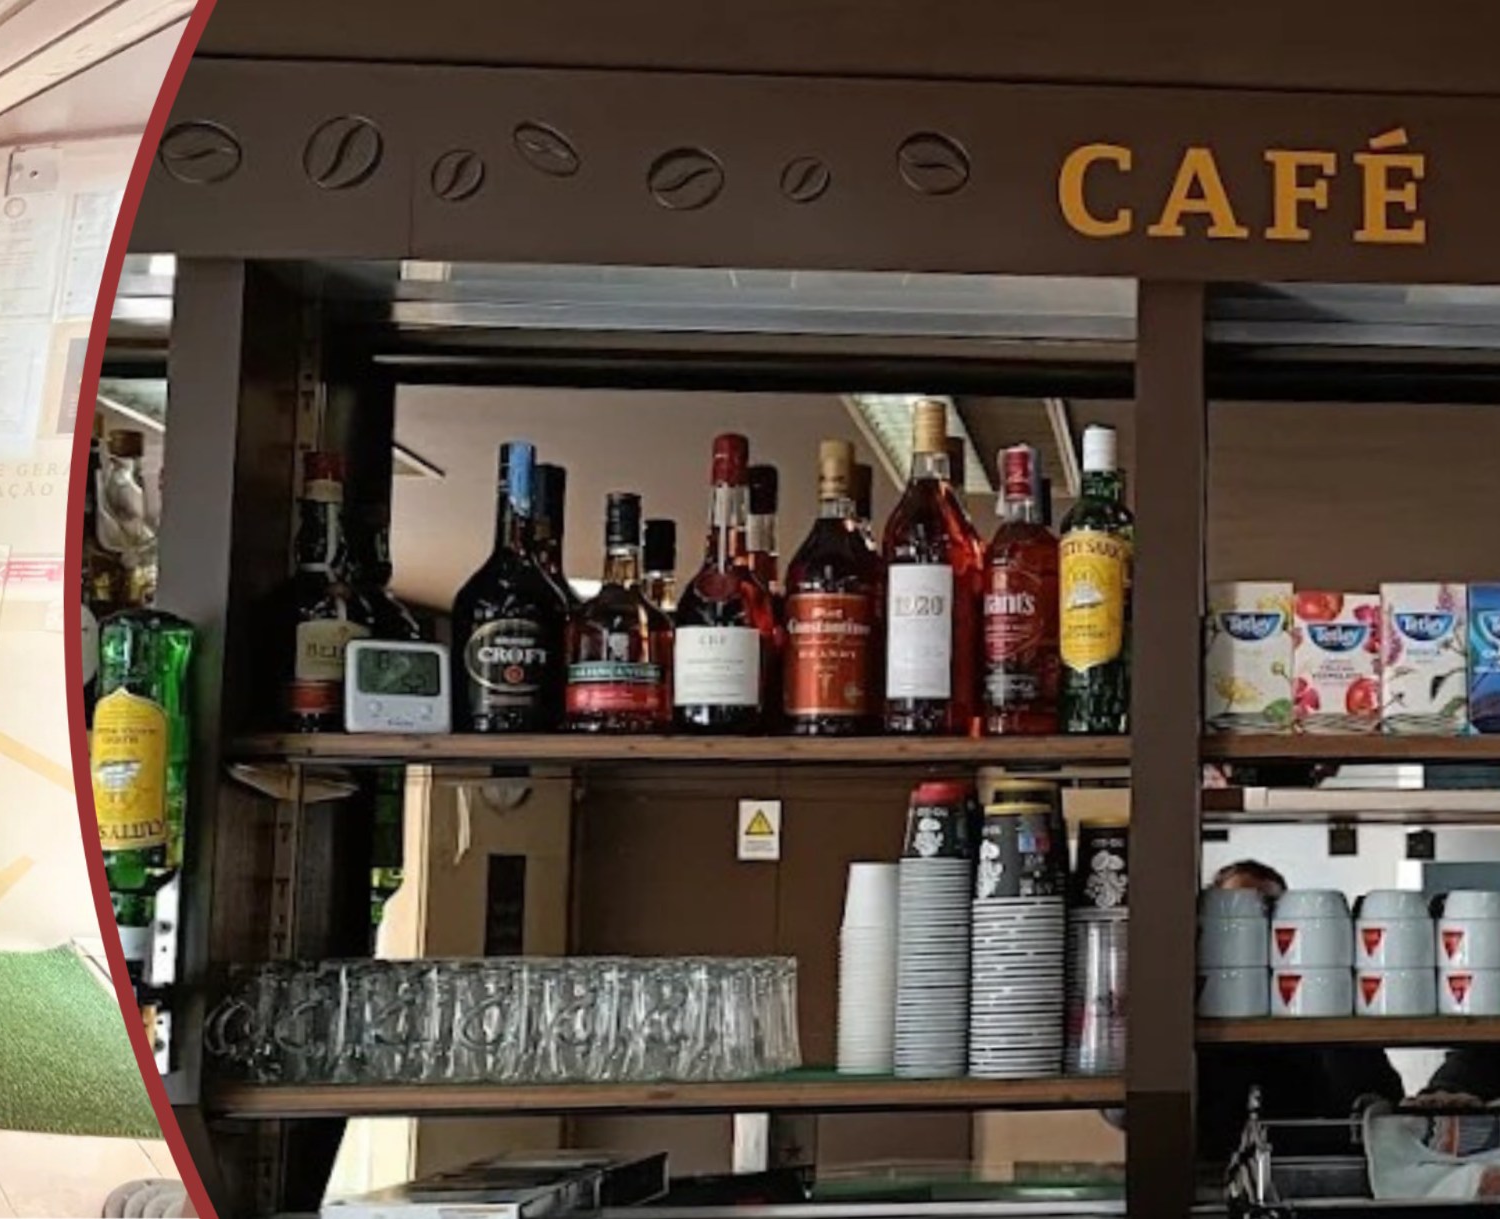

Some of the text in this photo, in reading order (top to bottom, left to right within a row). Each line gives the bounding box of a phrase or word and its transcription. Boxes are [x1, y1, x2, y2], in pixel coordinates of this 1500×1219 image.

[1057, 128, 1426, 244] CAFÉ
[984, 590, 1035, 616] rant's
[1226, 614, 1274, 635] Tetley
[1315, 625, 1363, 643] Tetley
[1404, 614, 1449, 634] Tetley
